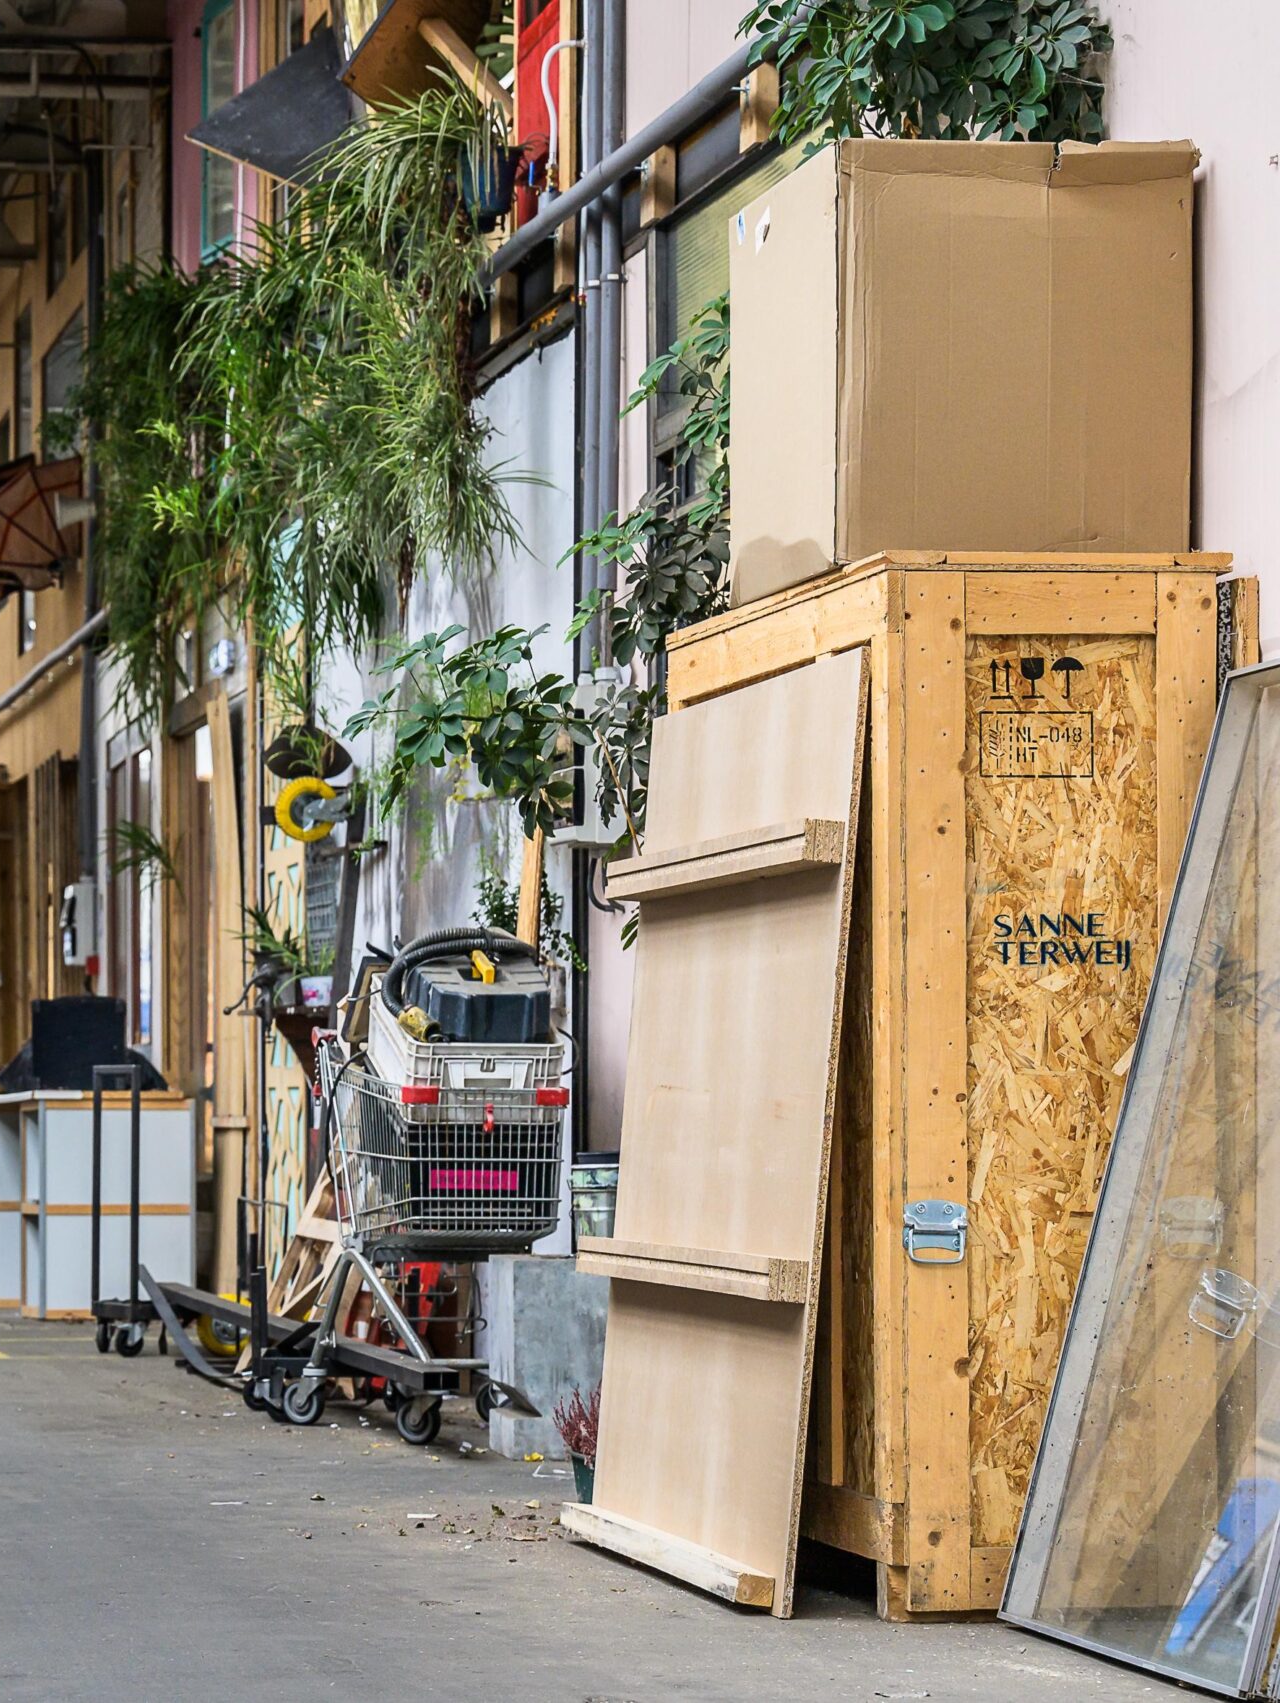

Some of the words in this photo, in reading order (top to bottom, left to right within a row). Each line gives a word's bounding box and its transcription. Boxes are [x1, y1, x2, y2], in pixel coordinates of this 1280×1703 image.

[1016, 727, 1082, 743] NL-048
[1016, 747, 1037, 763] HT
[993, 912, 1105, 938] SANNE
[994, 940, 1131, 971] TERWEIJ
